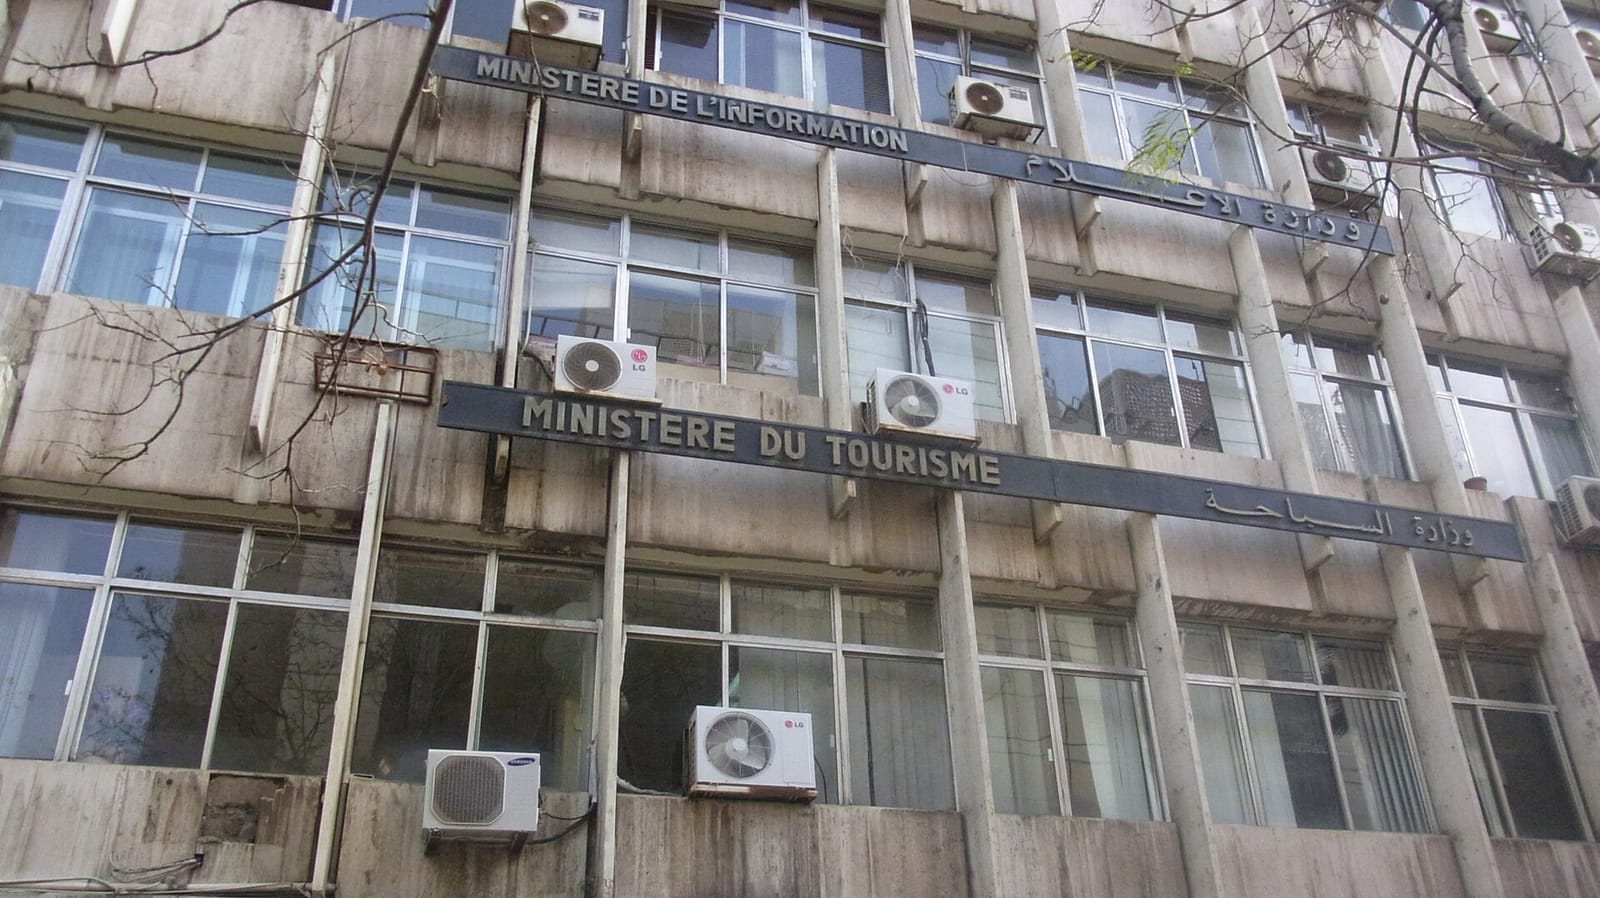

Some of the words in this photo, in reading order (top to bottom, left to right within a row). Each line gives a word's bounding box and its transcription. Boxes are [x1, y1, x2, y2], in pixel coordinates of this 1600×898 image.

[476, 55, 640, 104] MINISTERE
[649, 86, 688, 113] DE
[696, 94, 909, 153] L'INFORMATION
[632, 364, 646, 372] LG
[956, 387, 968, 395] LG
[521, 396, 736, 452] MINISTERE
[760, 426, 806, 460] DU
[827, 435, 1001, 486] TOURISME
[1204, 487, 1393, 536] السياحة
[1413, 515, 1474, 546] وزارة
